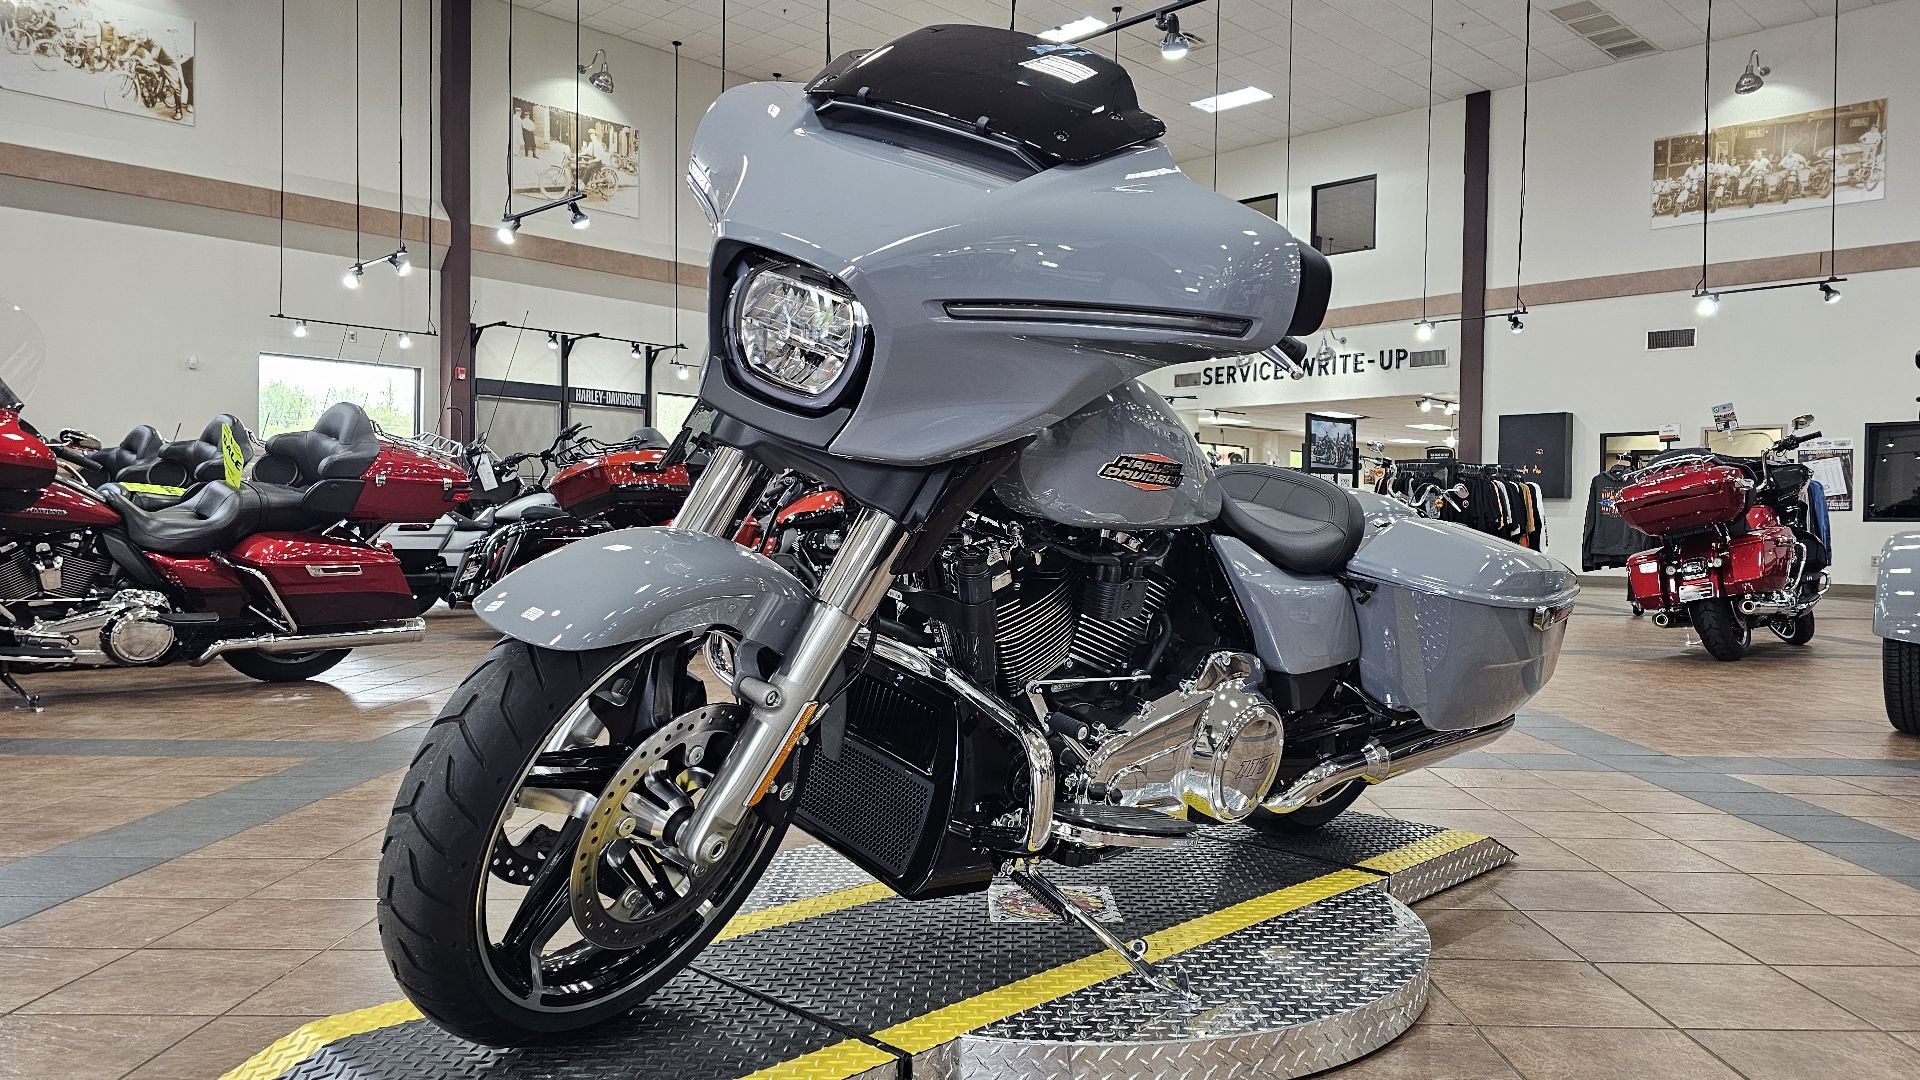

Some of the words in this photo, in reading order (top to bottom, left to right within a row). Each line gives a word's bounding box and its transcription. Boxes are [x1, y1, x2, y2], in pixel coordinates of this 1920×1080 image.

[1202, 361, 1284, 386] SERVICE
[1300, 349, 1409, 377] WRITE-UP
[575, 388, 642, 407] HARLEY-DAVIDSON
[1234, 753, 1274, 780] 117
